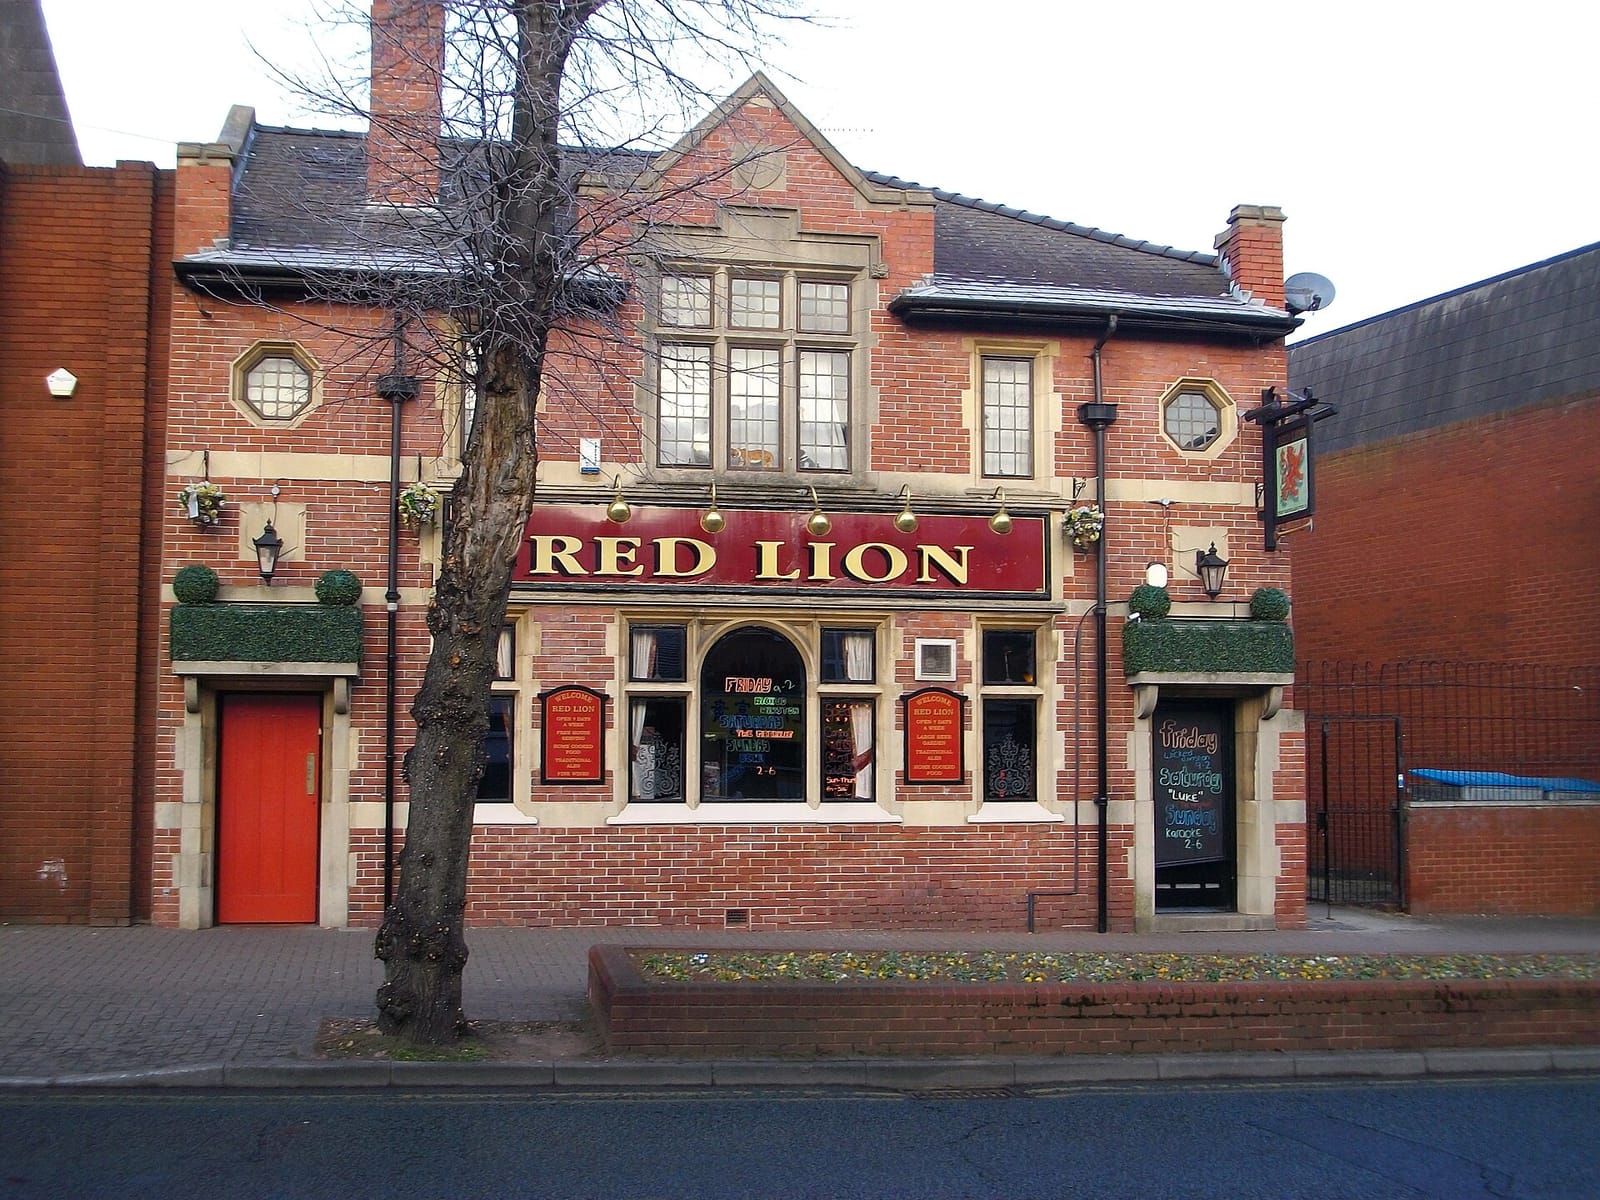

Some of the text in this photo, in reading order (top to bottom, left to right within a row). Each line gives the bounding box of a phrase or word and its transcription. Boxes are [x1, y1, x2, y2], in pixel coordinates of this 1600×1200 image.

[530, 535, 976, 584] RED LION
[725, 677, 772, 693] FRIDAY
[554, 692, 593, 703] WELCOME
[915, 695, 952, 707] WELCOME
[719, 715, 784, 729] SATURDAY
[726, 739, 771, 752] SUNDAY
[755, 766, 776, 775] 2-6
[1159, 766, 1223, 795] Saturday
[1164, 804, 1217, 835] Sunday
[1184, 839, 1203, 850] 2-6
